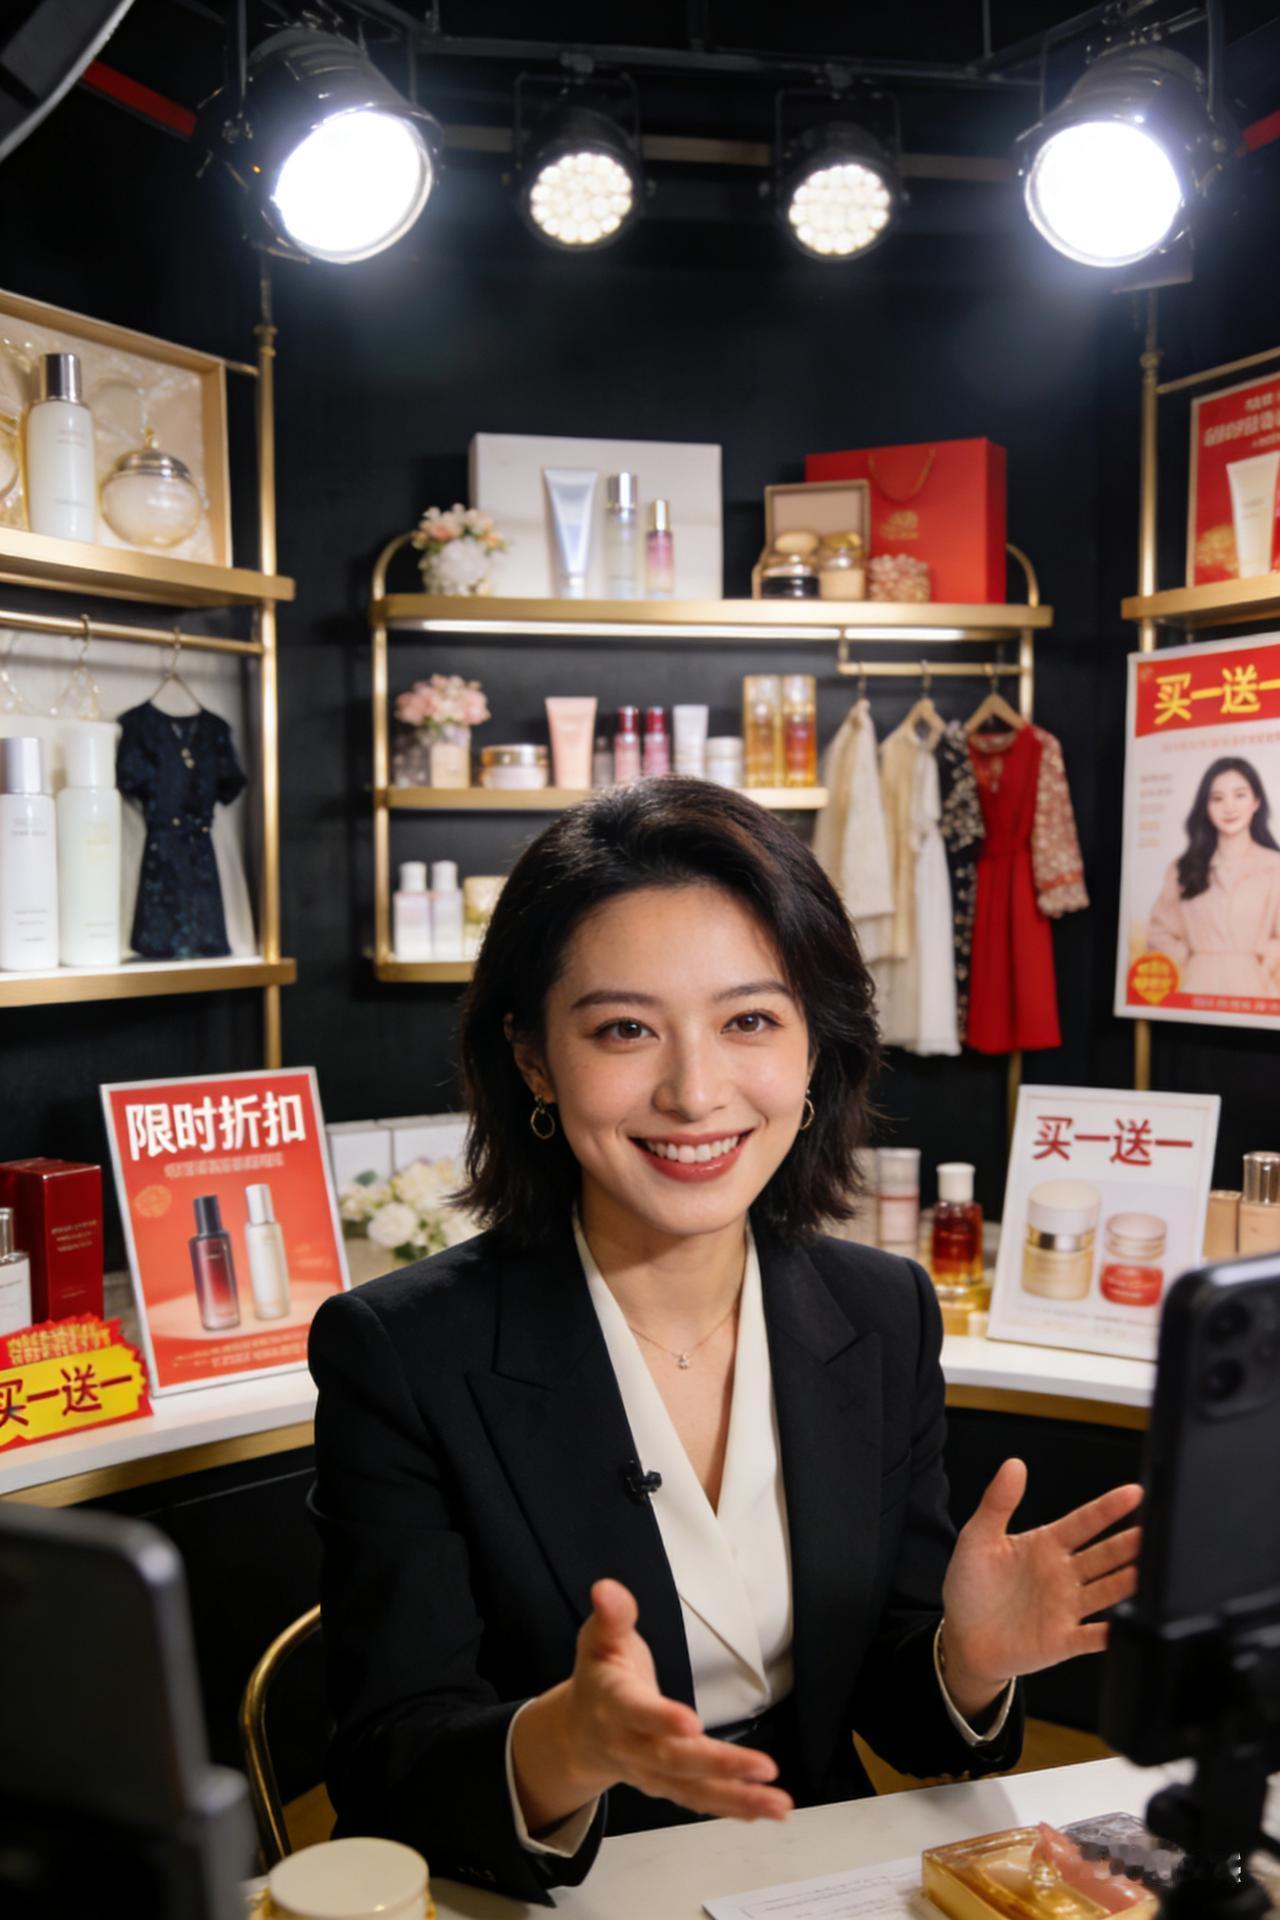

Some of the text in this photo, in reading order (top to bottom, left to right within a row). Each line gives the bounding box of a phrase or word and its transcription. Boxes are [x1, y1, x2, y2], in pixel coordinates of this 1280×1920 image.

[1153, 663, 1280, 725] 买一送一
[125, 1091, 306, 1161] 限时折扣
[1032, 1115, 1193, 1166] 买一送一
[0, 1364, 132, 1428] 买一送一
